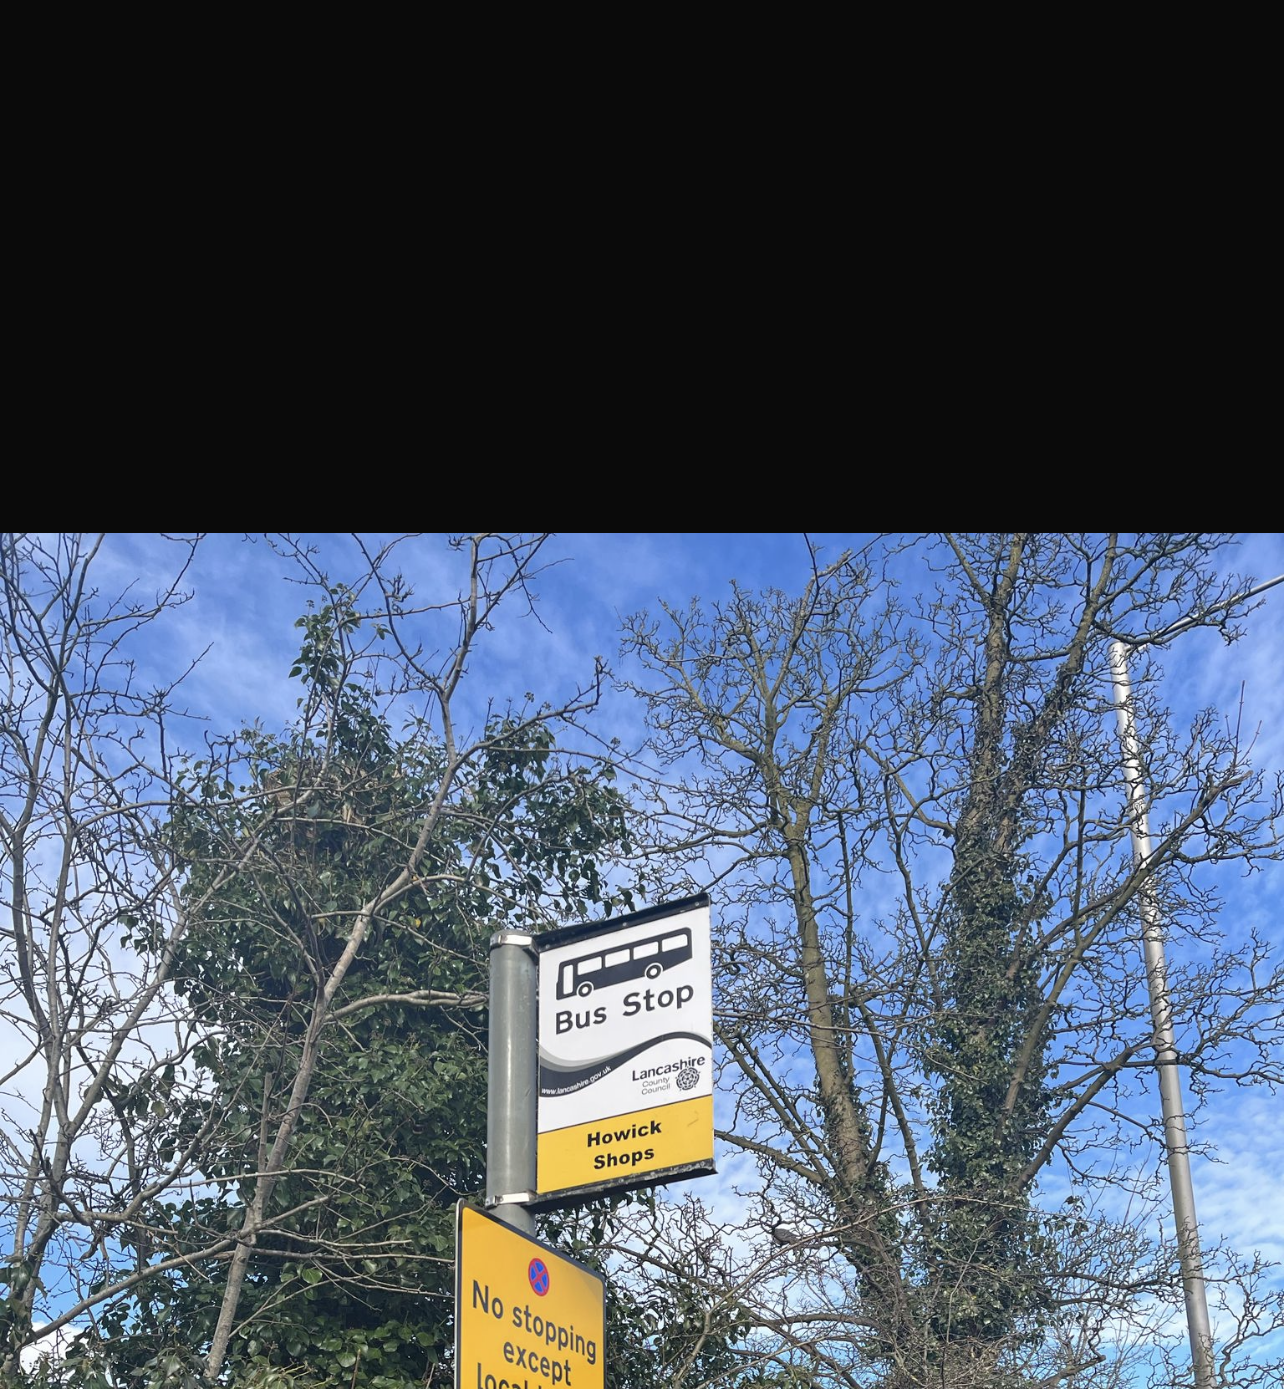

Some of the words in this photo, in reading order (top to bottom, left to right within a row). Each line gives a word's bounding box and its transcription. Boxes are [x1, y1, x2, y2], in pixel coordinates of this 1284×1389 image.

[556, 1007, 607, 1035] Bus
[622, 984, 694, 1017] Stop
[541, 1065, 612, 1095] www.lancashire.gov.uk
[632, 1056, 706, 1082] Lancashire
[642, 1076, 670, 1088] County
[641, 1083, 671, 1095] Council
[587, 1120, 662, 1148] Howick
[594, 1148, 655, 1170] Shops
[472, 1279, 504, 1320] No
[512, 1304, 596, 1365] stopping
[503, 1341, 572, 1387] except
